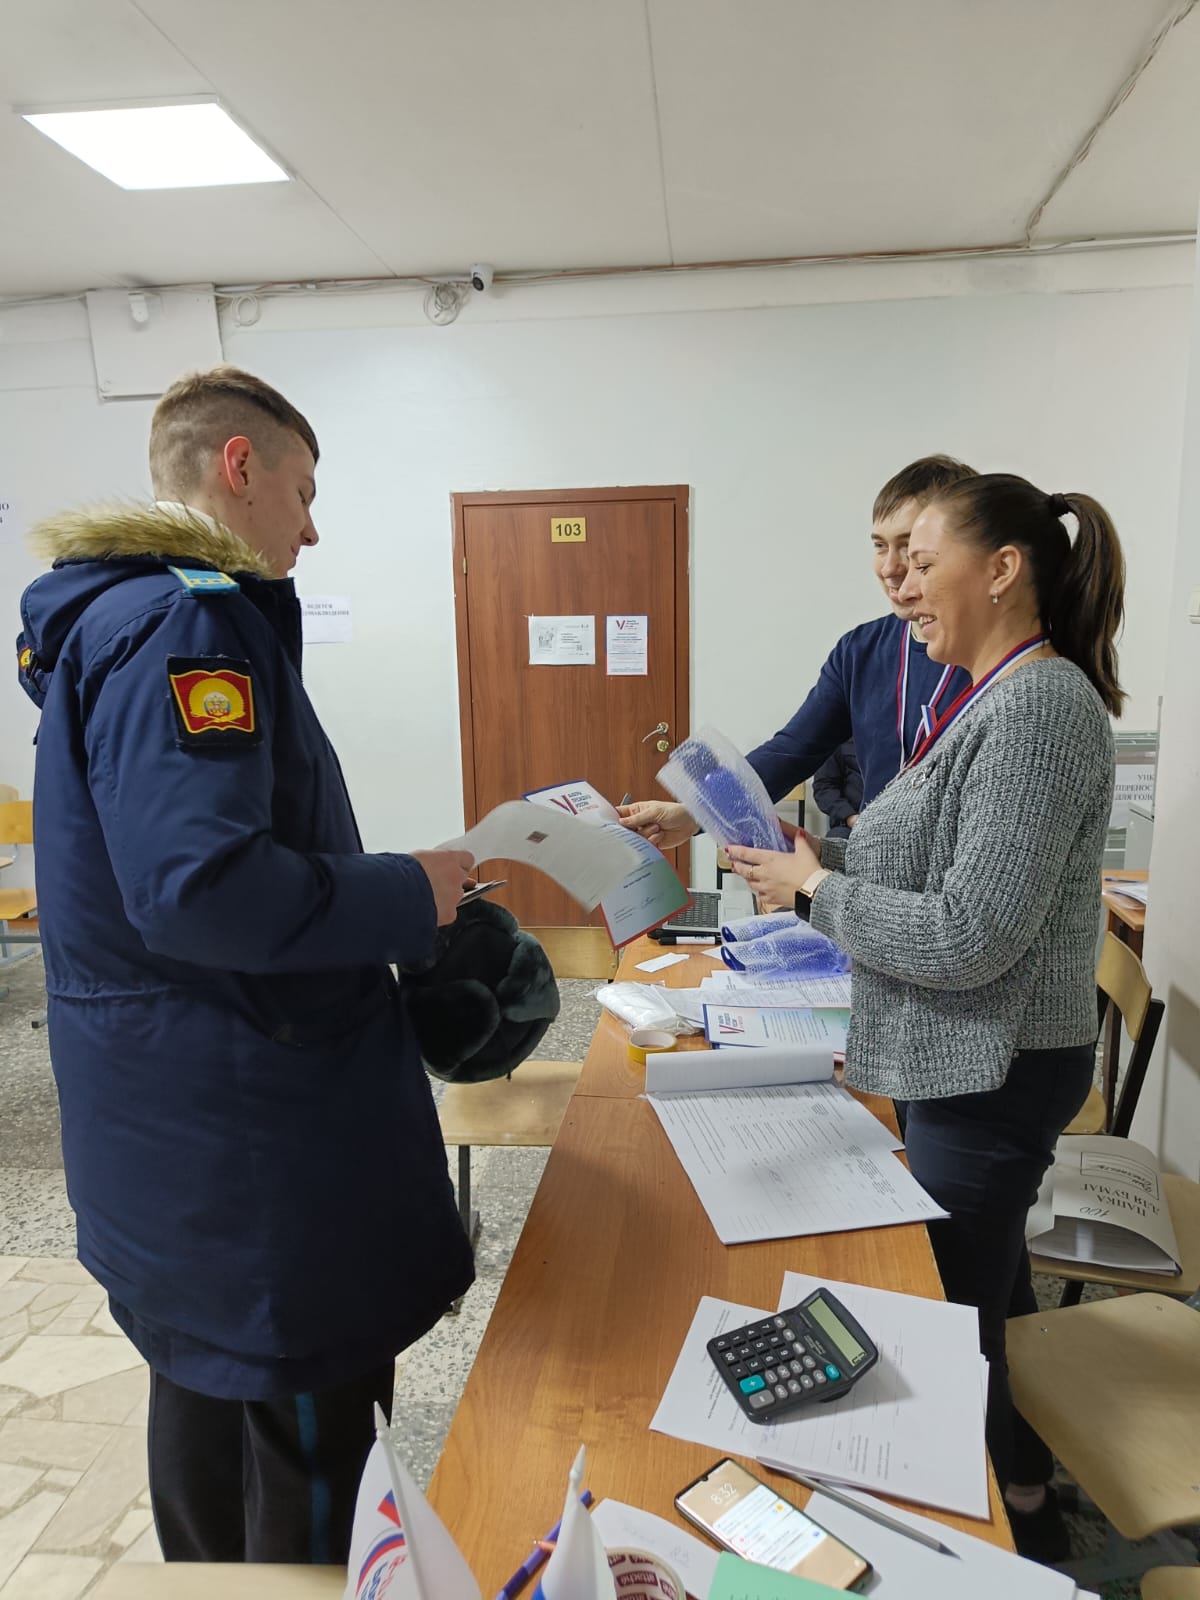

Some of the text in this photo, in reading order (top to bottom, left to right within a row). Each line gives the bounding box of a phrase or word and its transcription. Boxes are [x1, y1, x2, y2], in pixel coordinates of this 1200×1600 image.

[556, 523, 581, 537] 103
[1096, 1194, 1147, 1217] ПАПКА
[725, 1352, 735, 1361] 00
